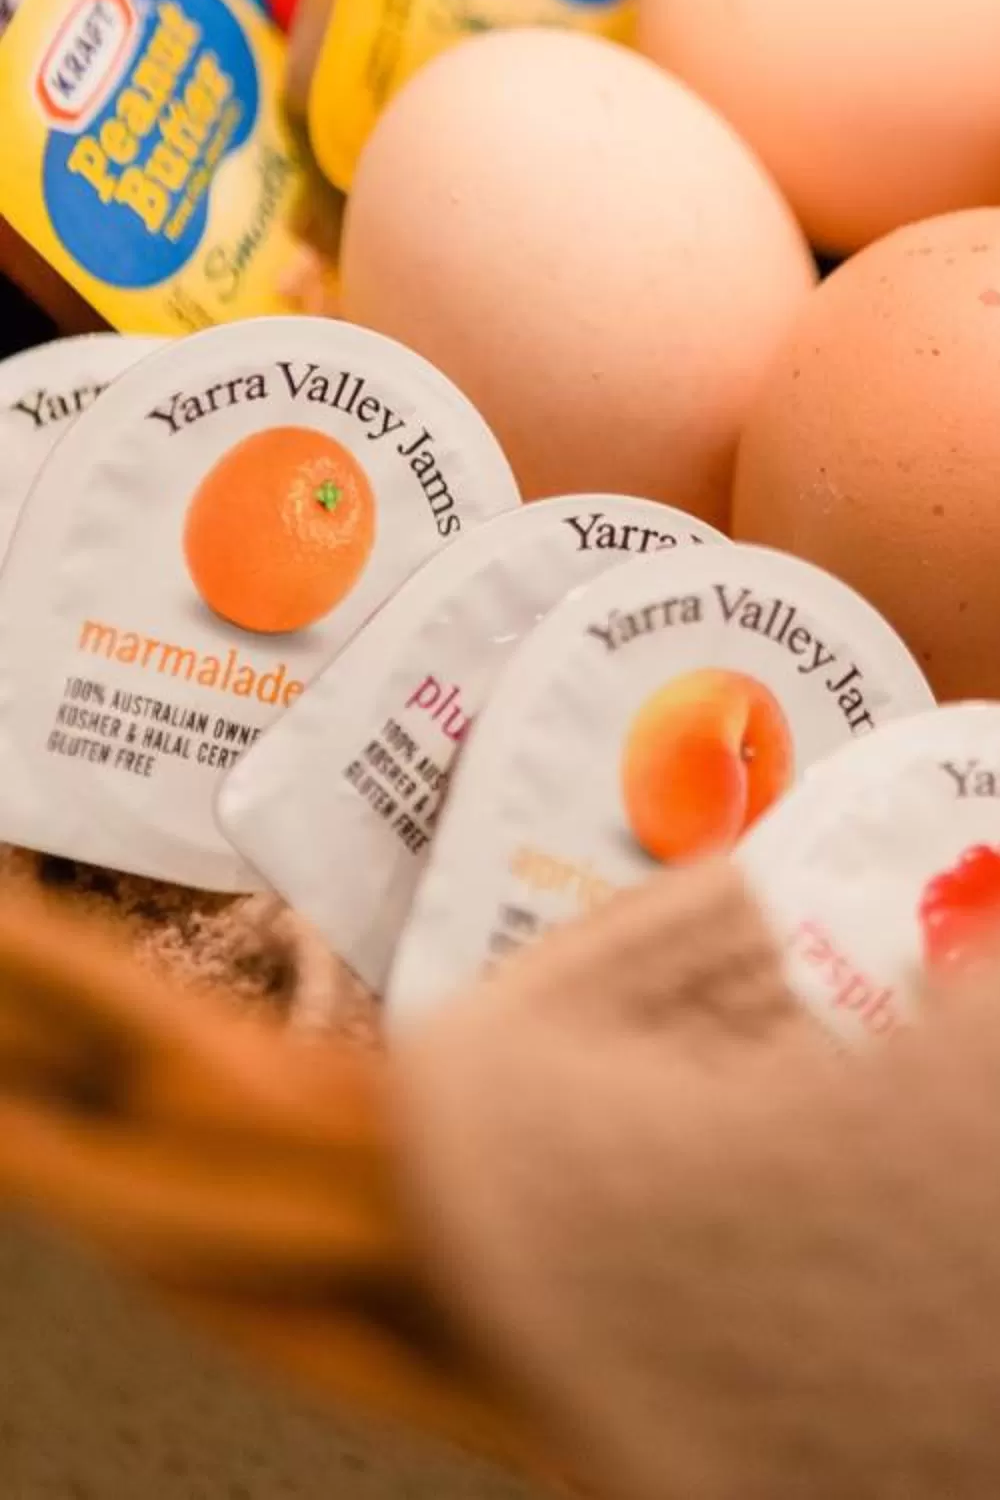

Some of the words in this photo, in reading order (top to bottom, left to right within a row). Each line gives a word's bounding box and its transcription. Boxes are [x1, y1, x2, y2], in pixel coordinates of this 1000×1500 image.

[52, 1, 116, 99] KRAFT
[67, 1, 201, 205] Peanut
[112, 50, 234, 235] Butter
[144, 372, 269, 436] Yarra
[276, 360, 404, 440] Valley
[396, 426, 462, 537] Jams
[78, 618, 304, 709] marmalade
[583, 594, 703, 652] Yarra
[712, 583, 838, 675] Valley
[54, 703, 122, 740] KOSHER
[125, 722, 138, 744] &
[142, 726, 193, 760] HALAL
[64, 676, 106, 708] 100%
[108, 689, 211, 737] AUSTRALIAN
[46, 730, 112, 767] GLUTEN
[113, 747, 156, 779] FREE
